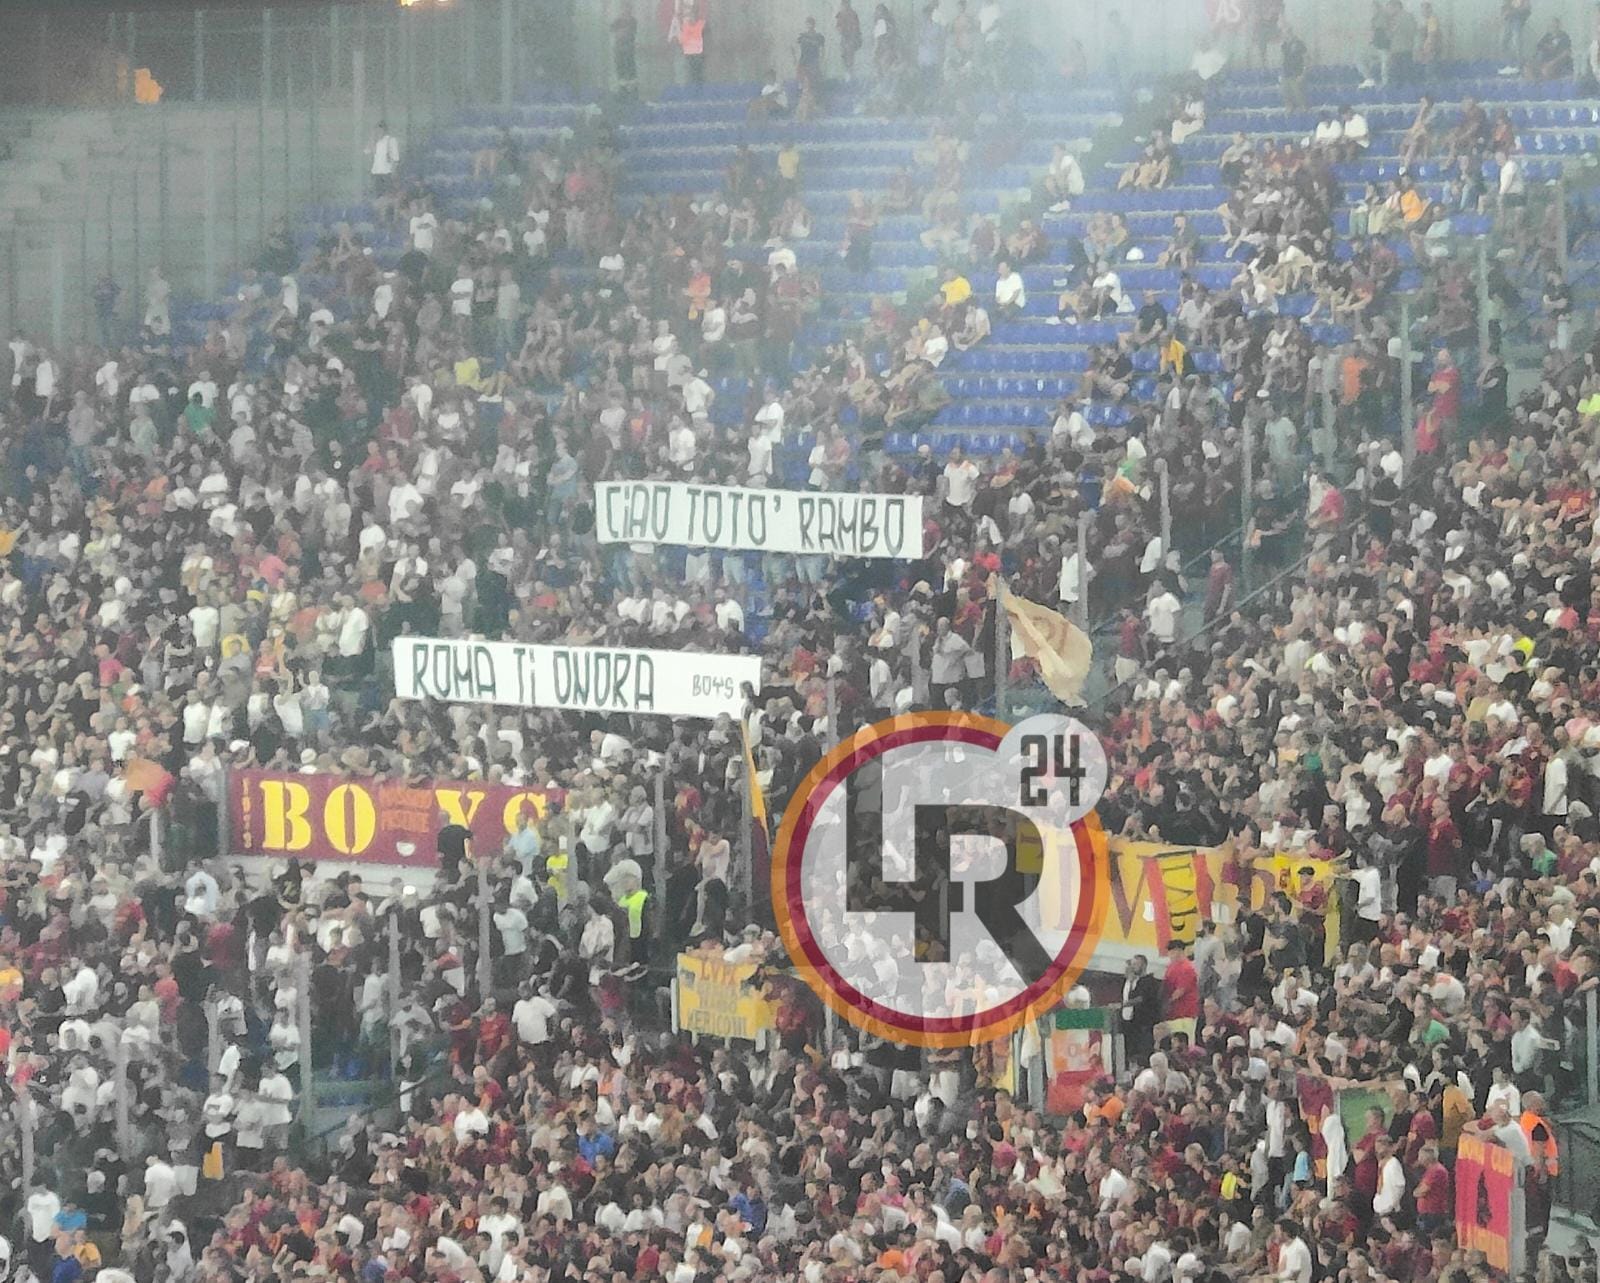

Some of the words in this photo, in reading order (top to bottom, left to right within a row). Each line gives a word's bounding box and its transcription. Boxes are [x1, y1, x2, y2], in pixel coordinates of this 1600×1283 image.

[798, 497, 904, 556] RAMBO
[412, 643, 497, 700] ROMA
[552, 649, 654, 710] ONORA
